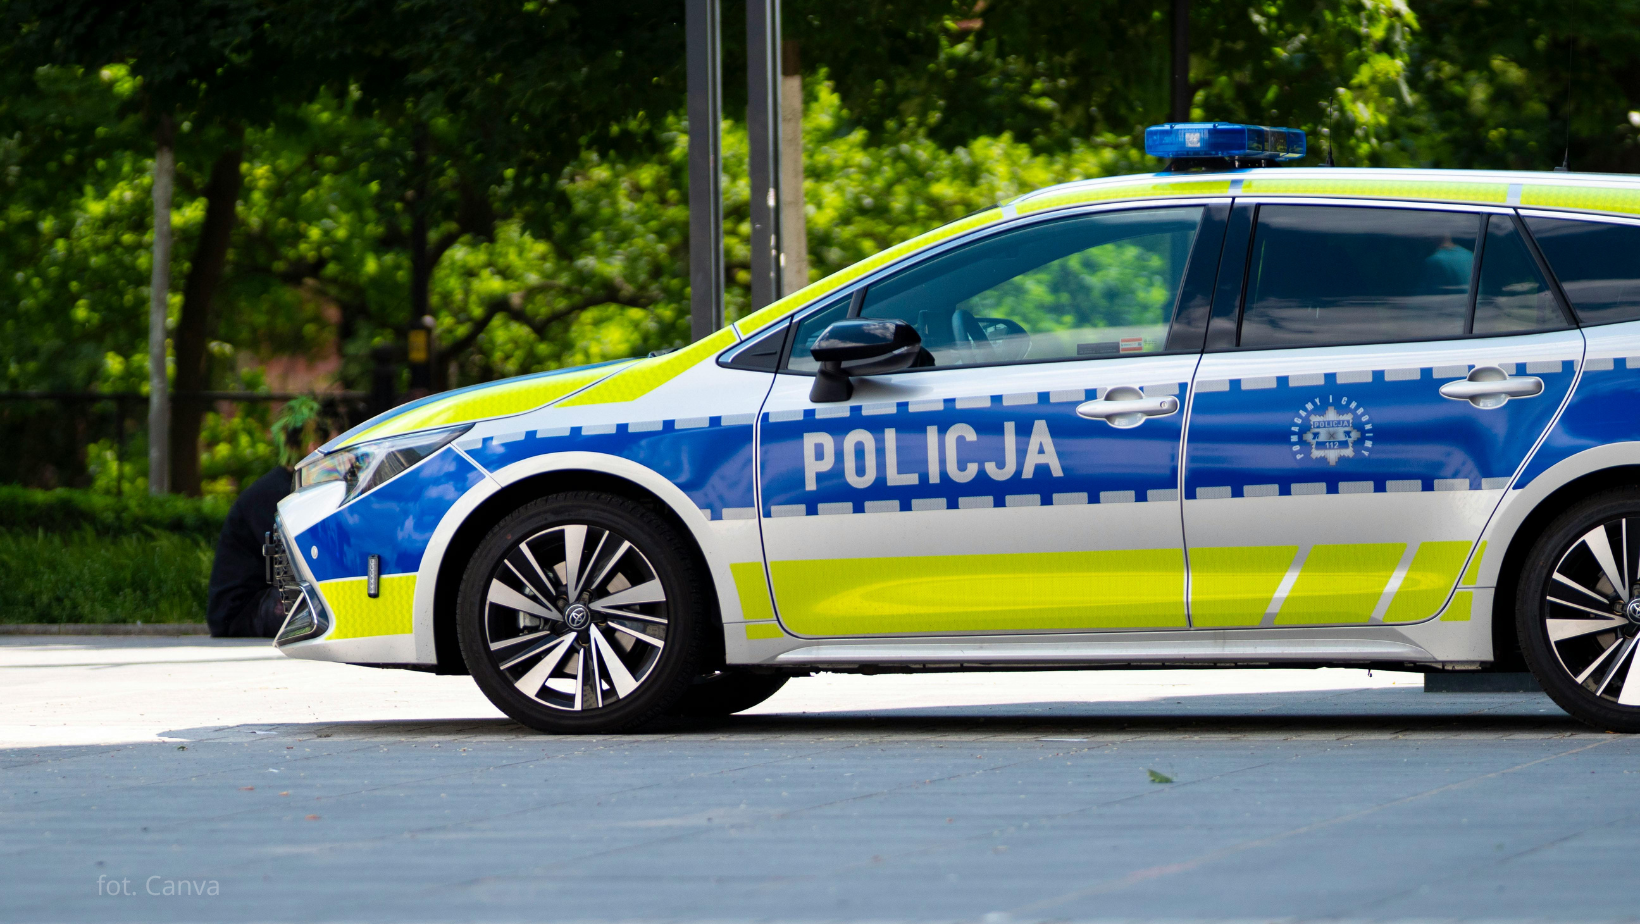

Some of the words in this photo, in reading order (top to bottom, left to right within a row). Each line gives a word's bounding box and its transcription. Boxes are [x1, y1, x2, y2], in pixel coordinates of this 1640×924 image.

[803, 419, 1064, 491] POLICJA
[1290, 397, 1320, 460] POMAGAMY
[1341, 396, 1373, 457] CHRONIMY
